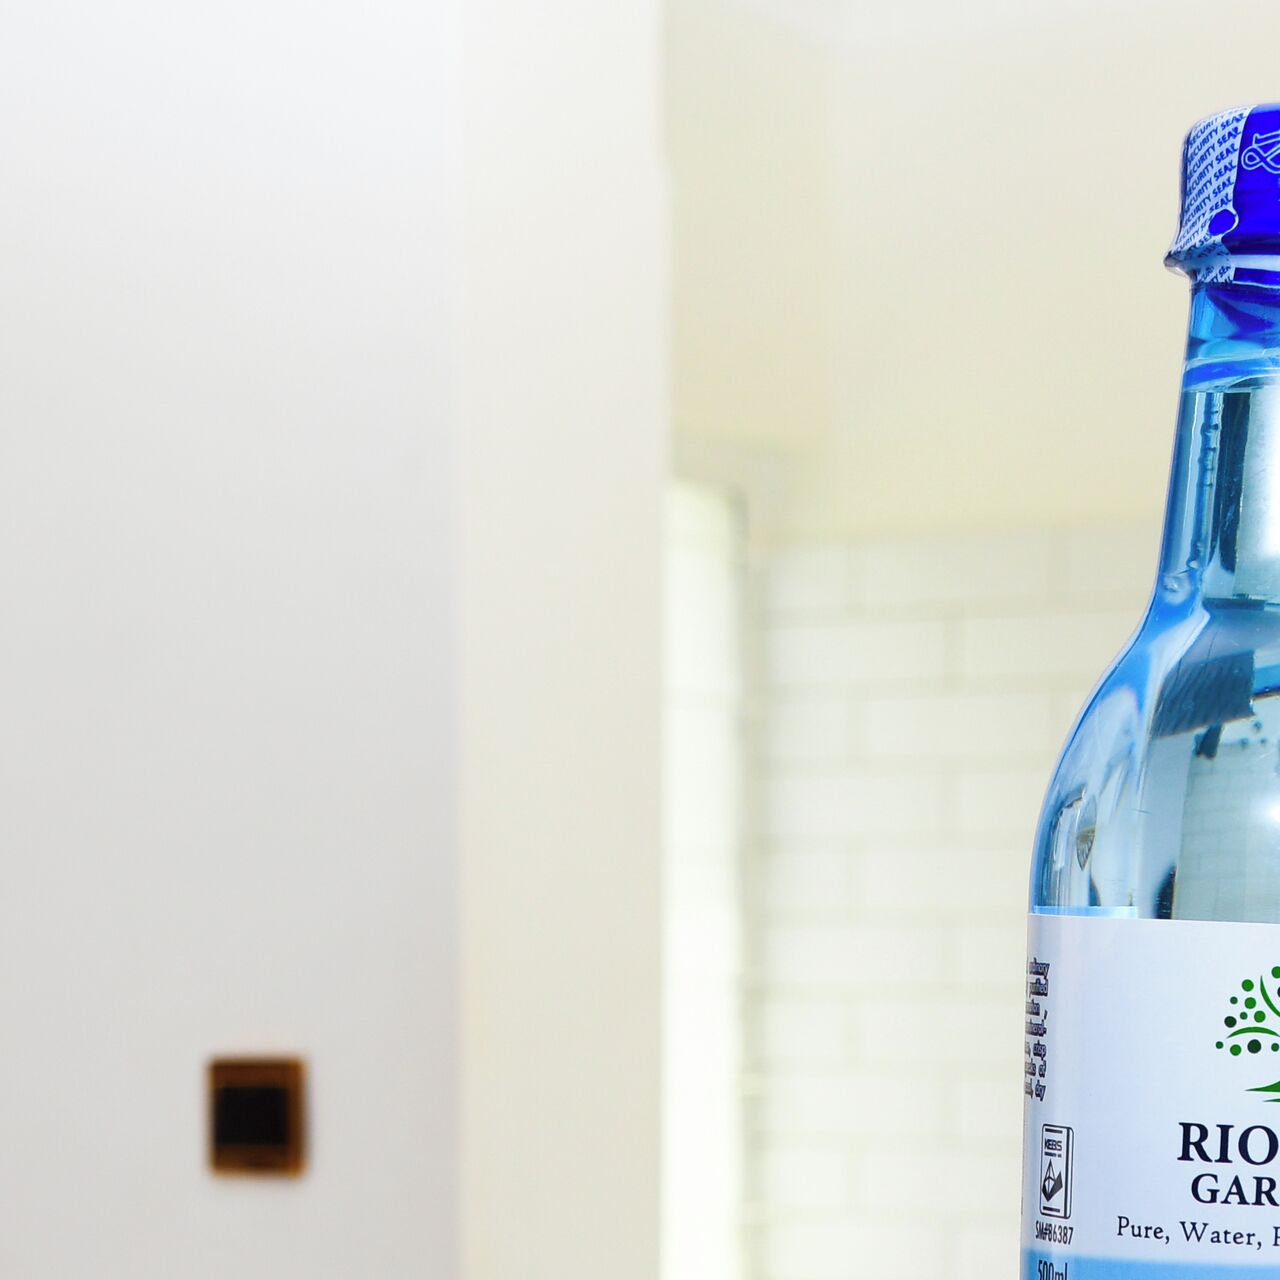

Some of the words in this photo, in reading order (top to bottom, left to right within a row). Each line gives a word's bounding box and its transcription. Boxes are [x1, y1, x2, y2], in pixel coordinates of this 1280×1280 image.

[1217, 126, 1241, 147] SEAL
[1215, 143, 1238, 164] SEAL
[1214, 159, 1236, 181] SEAL
[1213, 176, 1234, 197] SEAL
[1177, 1122, 1279, 1166] RIO
[1116, 1215, 1170, 1245] Pure,
[1179, 1221, 1262, 1251] Water,
